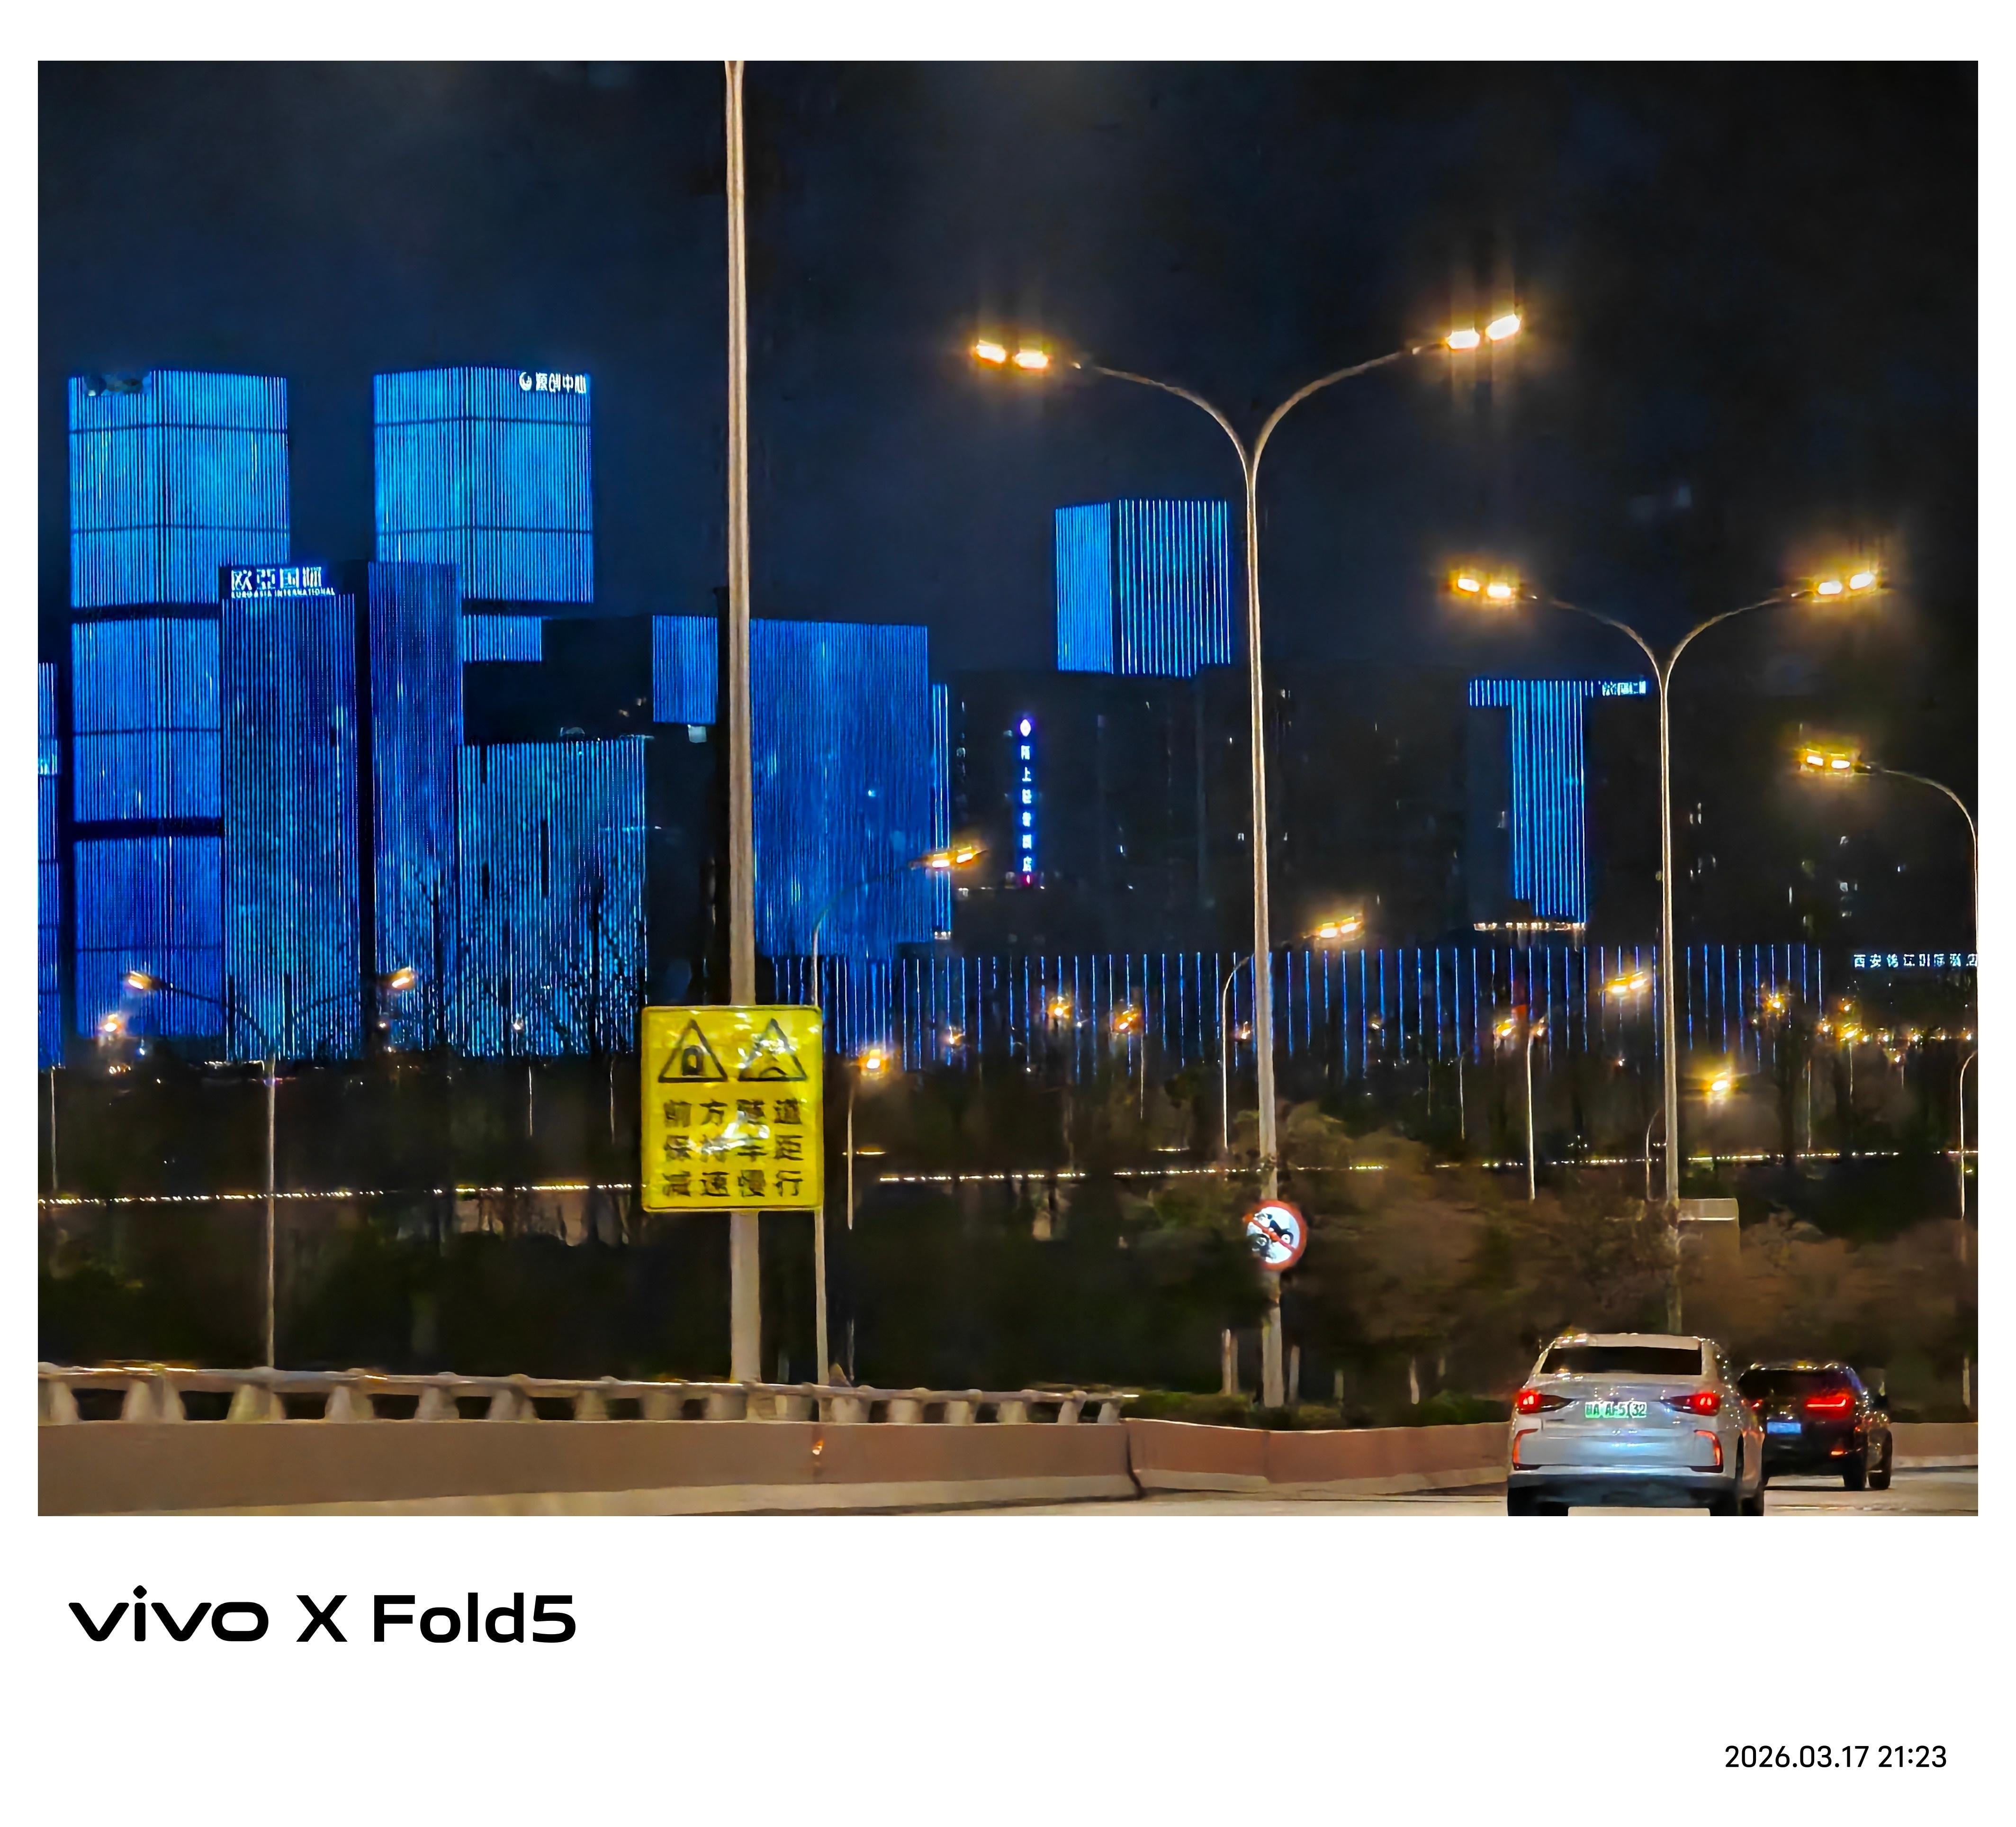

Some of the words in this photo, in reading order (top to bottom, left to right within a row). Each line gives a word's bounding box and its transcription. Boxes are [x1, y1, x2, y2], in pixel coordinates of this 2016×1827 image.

[664, 1098, 803, 1128] 前方隧道
[662, 1169, 804, 1197] 减速慢行
